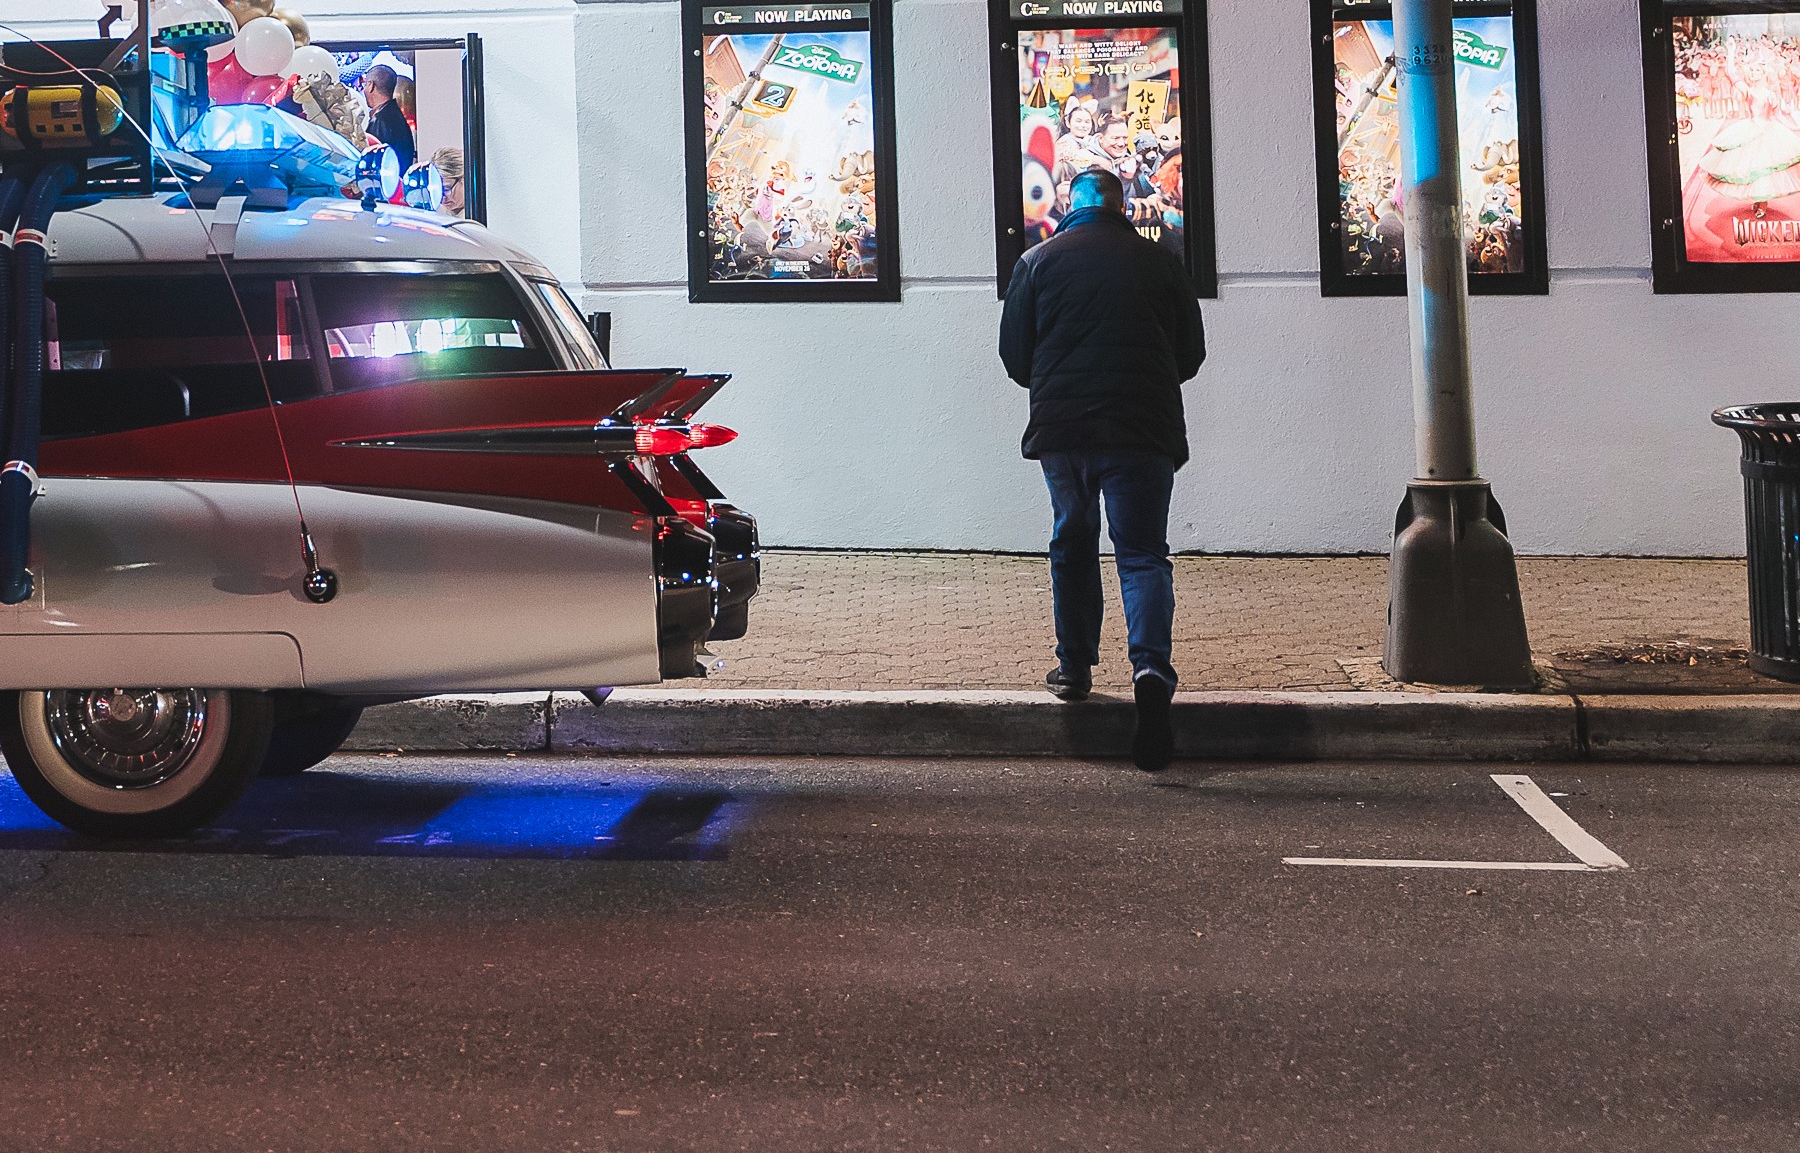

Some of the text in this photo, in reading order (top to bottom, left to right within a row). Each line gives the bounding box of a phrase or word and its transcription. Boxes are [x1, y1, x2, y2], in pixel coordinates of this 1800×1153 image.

[755, 10, 788, 24] NOW
[794, 9, 852, 22] PLAYING
[1063, 2, 1098, 15] NOW
[1104, 0, 1163, 14] PLAYING
[774, 49, 857, 79] ZOOTOPIA
[761, 85, 786, 106] 2
